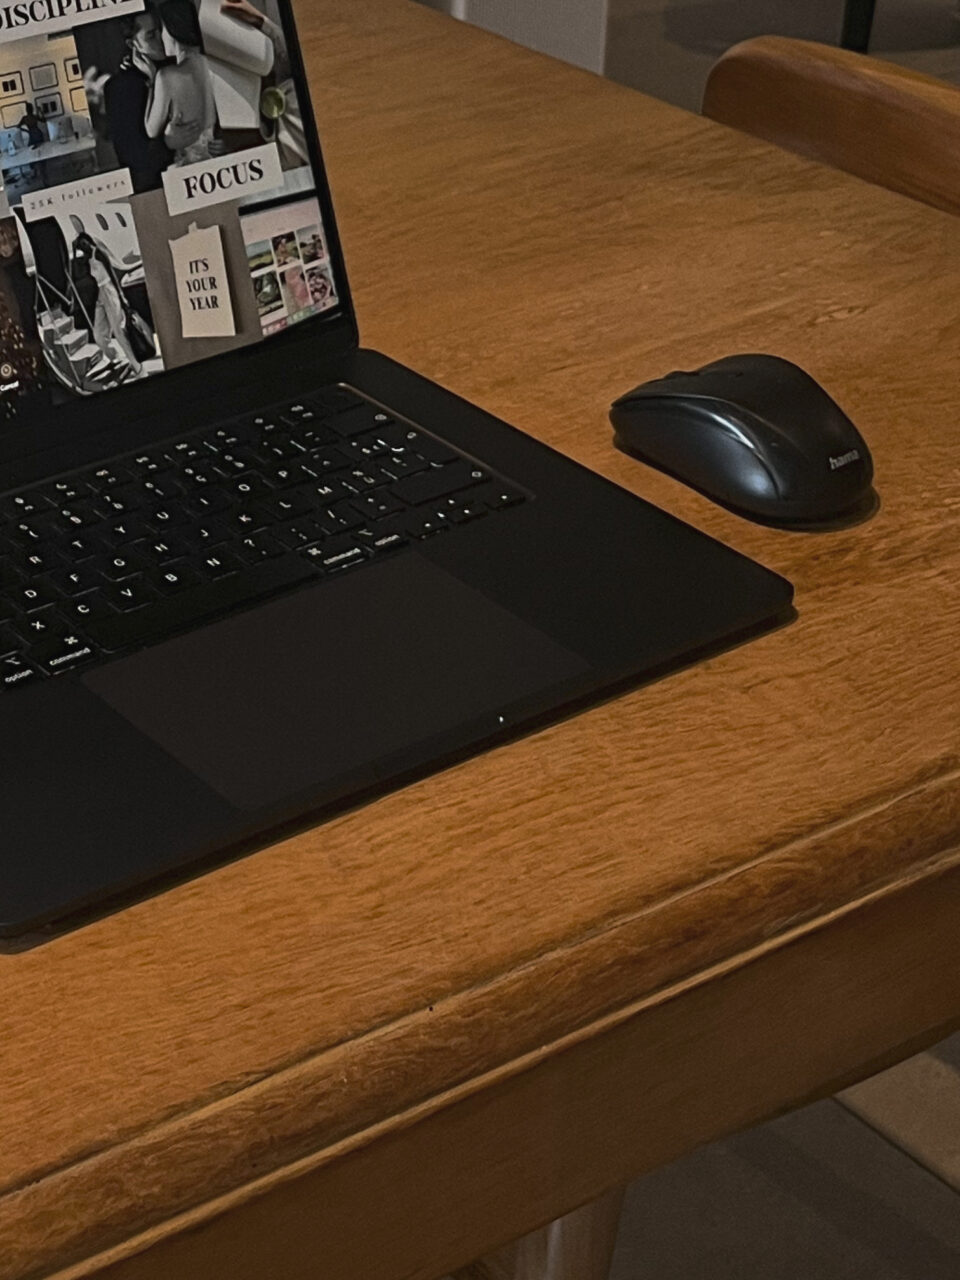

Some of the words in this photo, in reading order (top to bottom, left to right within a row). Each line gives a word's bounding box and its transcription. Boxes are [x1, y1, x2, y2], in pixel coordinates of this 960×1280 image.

[183, 159, 264, 199] FOCUS
[61, 180, 126, 201] followers
[186, 276, 218, 293] YOUR
[189, 295, 219, 311] YEAR
[5, 670, 32, 682] option
